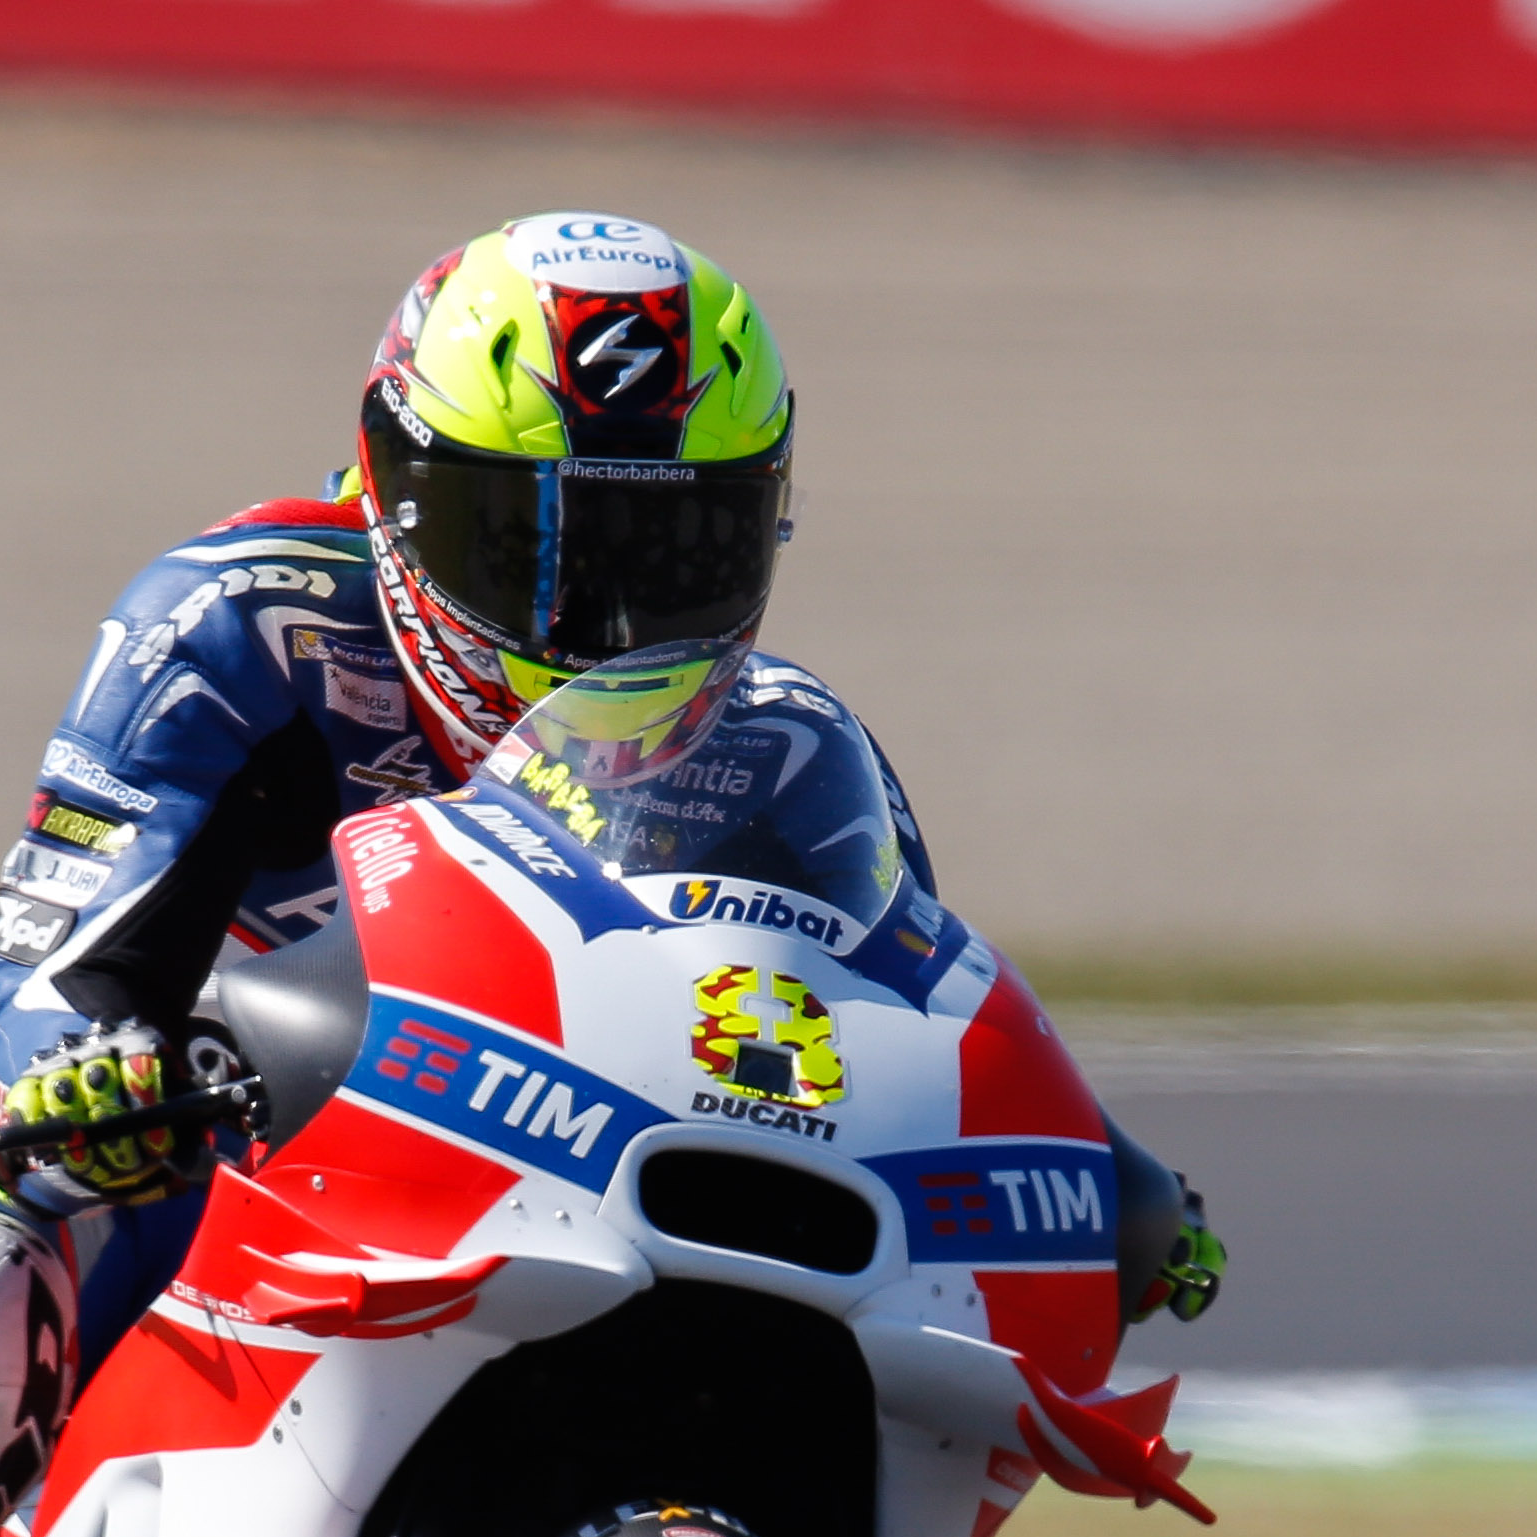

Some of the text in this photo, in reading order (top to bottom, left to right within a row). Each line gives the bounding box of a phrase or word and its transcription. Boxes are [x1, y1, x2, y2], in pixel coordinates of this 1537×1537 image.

[381, 378, 432, 447] EXO-2000
[557, 459, 695, 481] @hectorbarbera
[424, 581, 521, 651] Apps Implantadores
[564, 653, 599, 669] Apps
[67, 757, 154, 810] AirEuropa
[669, 879, 845, 948] Unibat
[690, 963, 846, 1111] 8
[468, 1049, 615, 1160] TIM
[690, 1090, 839, 1143] DUCATI
[988, 1168, 1104, 1233] TIM
